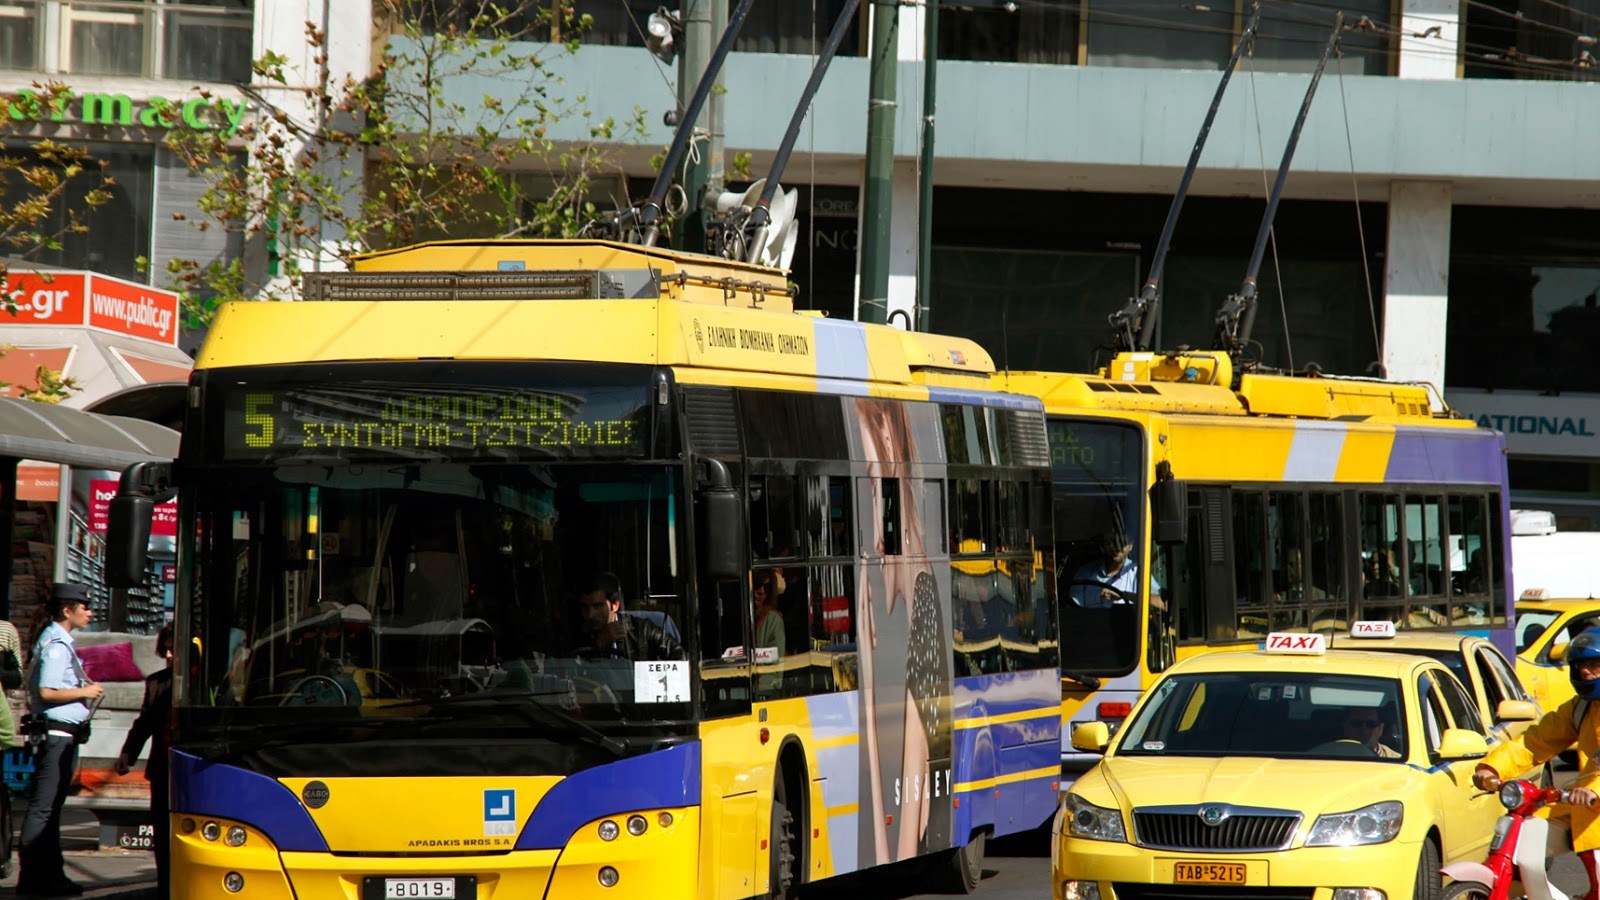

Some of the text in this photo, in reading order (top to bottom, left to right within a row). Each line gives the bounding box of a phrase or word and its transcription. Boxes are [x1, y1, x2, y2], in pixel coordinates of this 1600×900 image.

[92, 292, 172, 337] www.public.gr
[244, 394, 274, 447] 5
[1468, 413, 1595, 436] ATIONAL
[1269, 636, 1319, 649] TAXI
[658, 675, 668, 692] 1
[895, 769, 951, 806] SISLEY
[408, 839, 461, 847] APADAKIS
[463, 838, 491, 846] BROS
